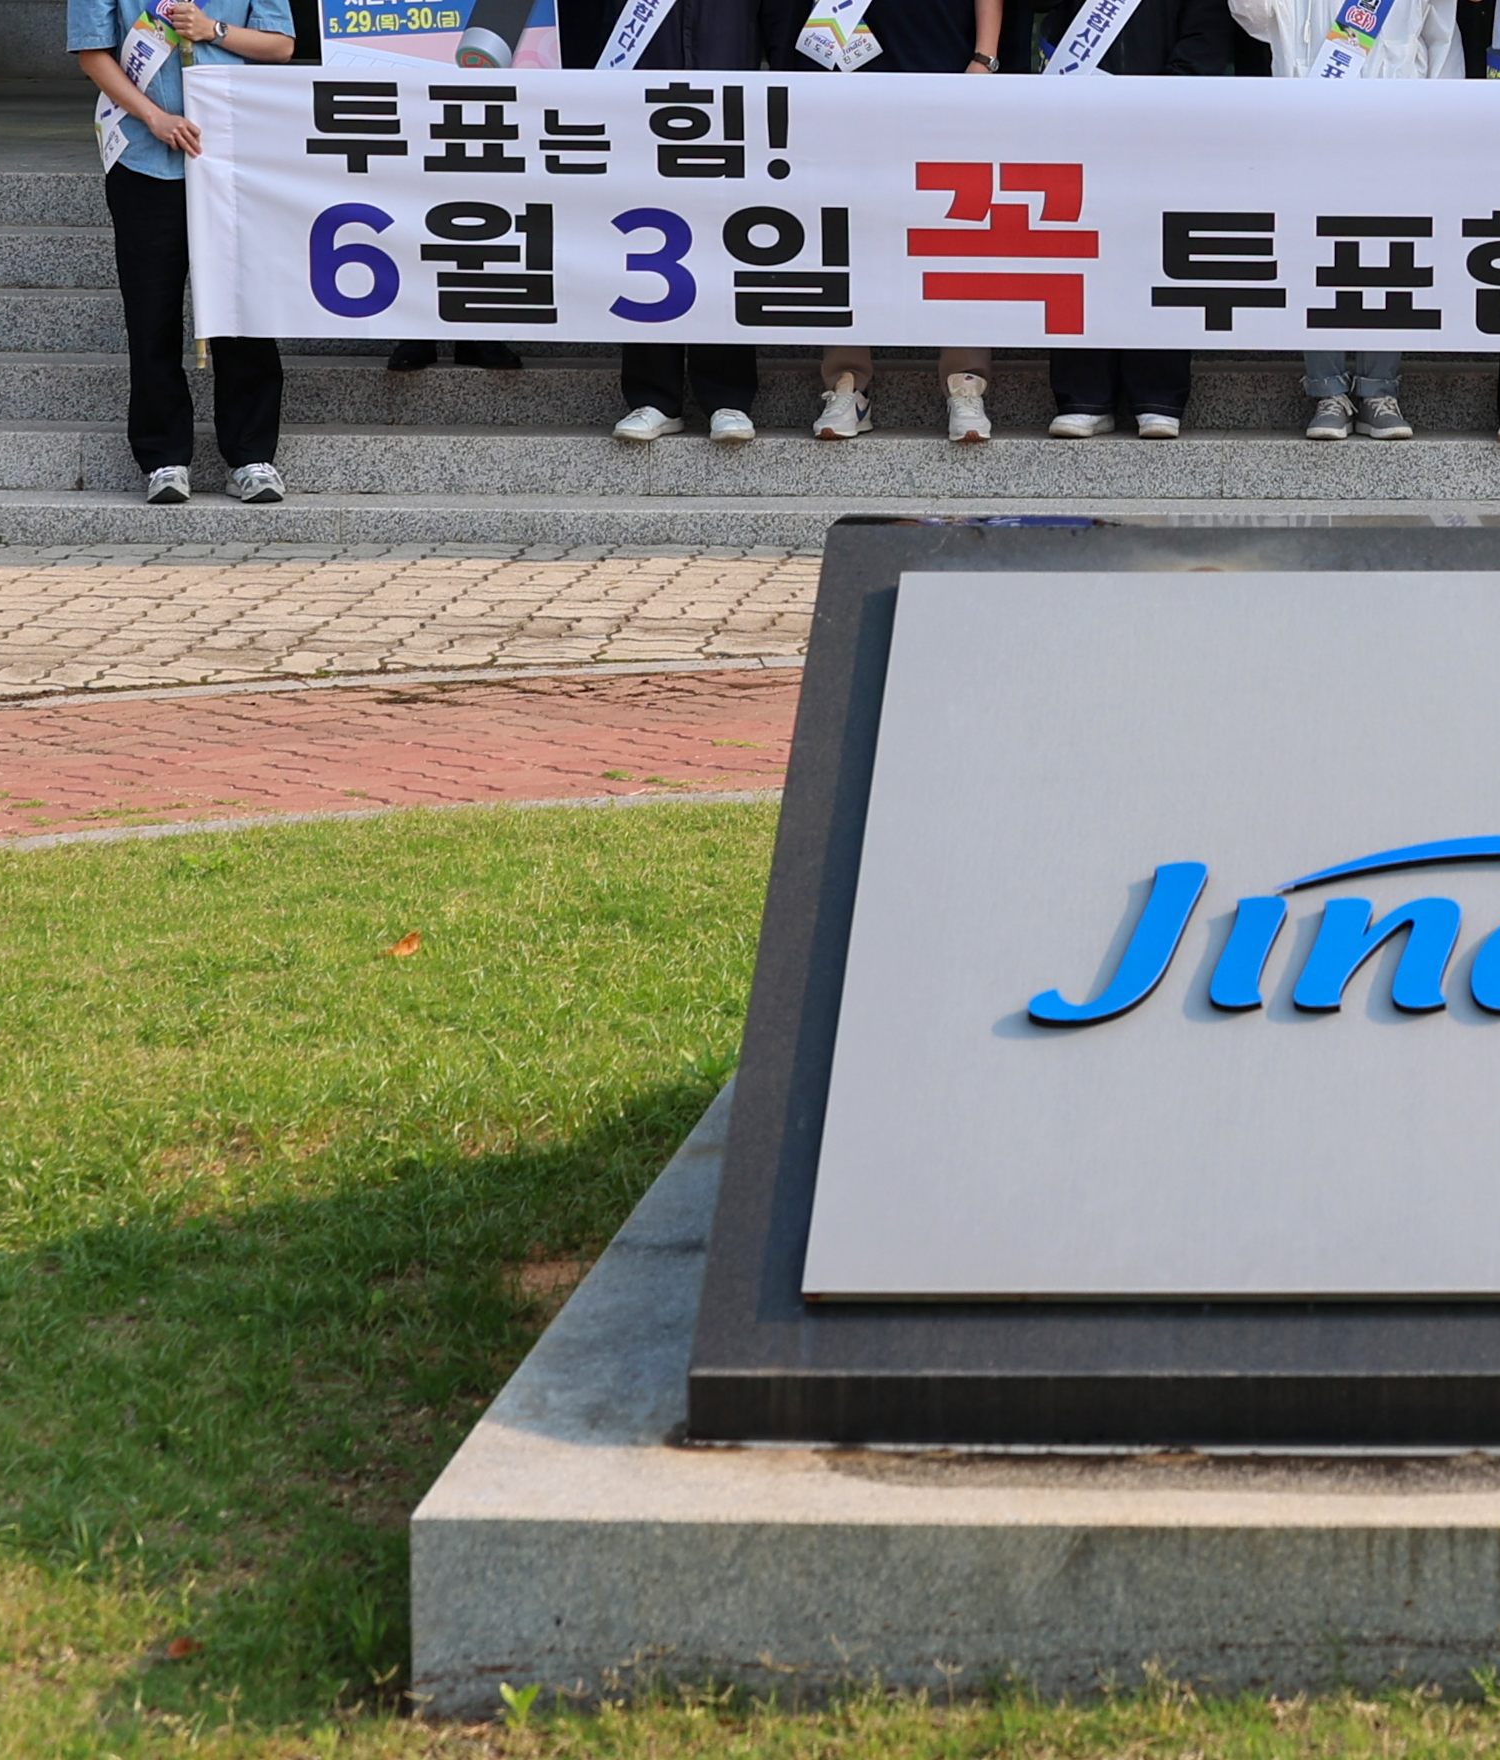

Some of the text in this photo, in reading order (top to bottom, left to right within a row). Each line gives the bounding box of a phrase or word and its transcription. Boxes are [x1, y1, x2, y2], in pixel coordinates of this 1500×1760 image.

[305, 80, 792, 182] 투표는 힘!
[308, 200, 559, 324] 6월
[608, 204, 854, 328] 3일
[906, 160, 1100, 336] 꼭
